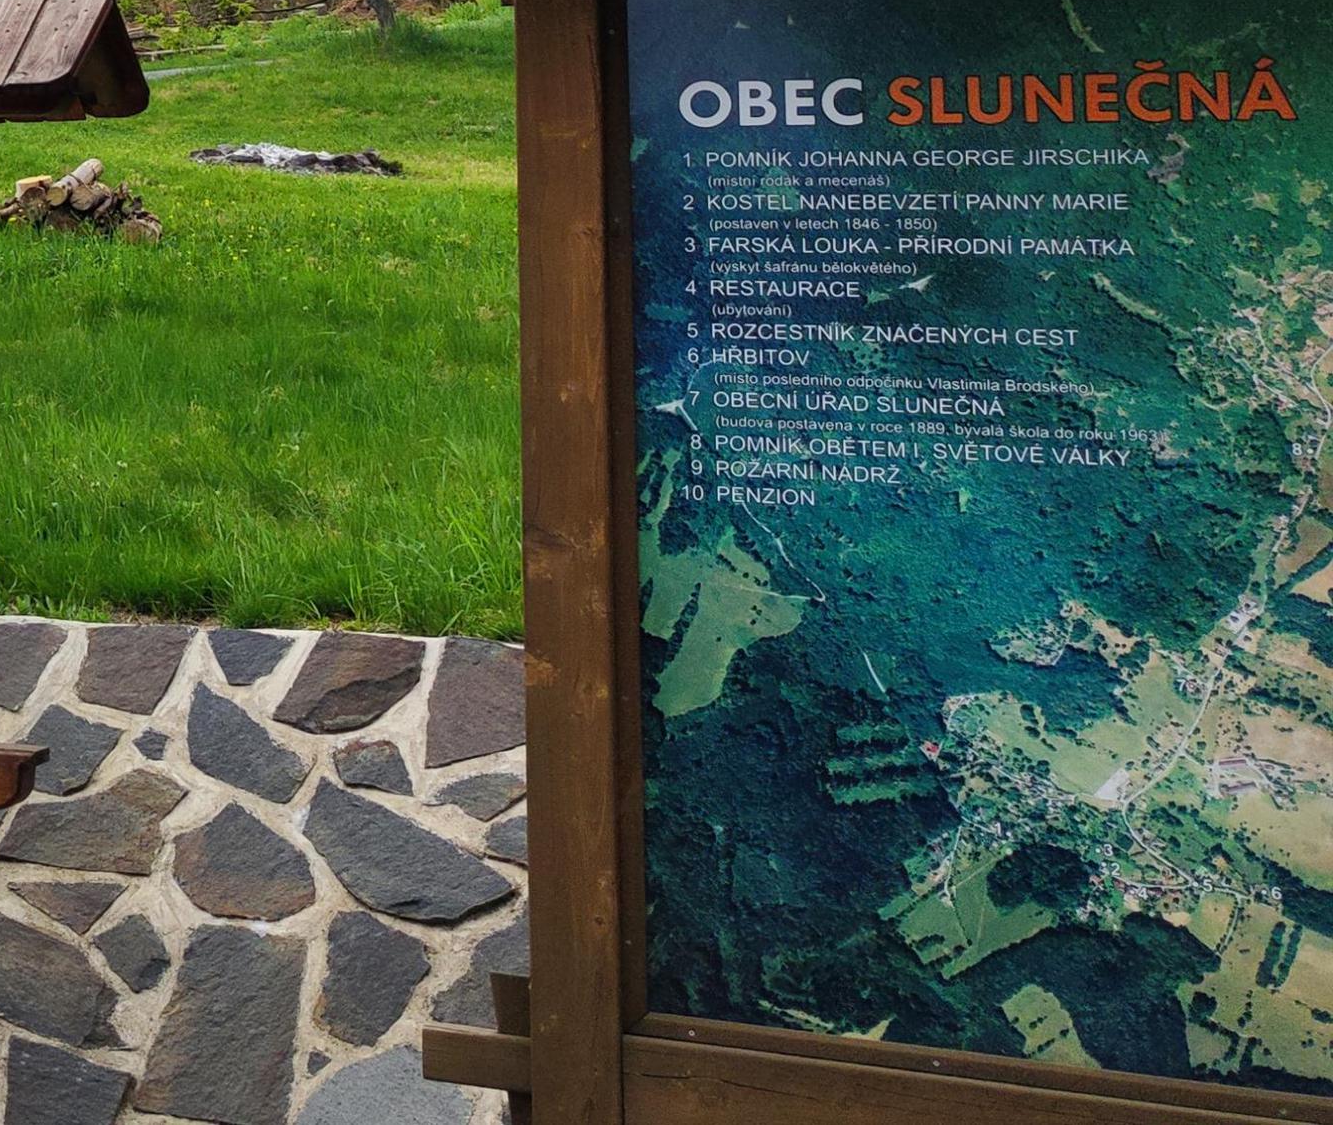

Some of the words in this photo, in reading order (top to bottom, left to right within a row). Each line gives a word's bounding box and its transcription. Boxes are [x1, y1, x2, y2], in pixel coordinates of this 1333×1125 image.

[678, 78, 864, 128] OBEC
[887, 56, 1298, 127] SLUNEČNÁ
[683, 153, 691, 168] 1
[706, 149, 792, 168] POMNÍK
[799, 150, 907, 167] JOHANNA
[913, 149, 1014, 167] GEORGE
[1023, 148, 1149, 166] JIRSCHIKA
[804, 177, 813, 187] a
[818, 173, 891, 187] mecenáš)
[683, 195, 694, 210] 2
[707, 194, 799, 210] KOSTEL
[800, 190, 958, 210] NANEBEVZETÍ
[966, 194, 1044, 210] PANNY
[1053, 193, 1129, 210] MARIE
[709, 218, 779, 232] (postaven
[783, 221, 791, 229] v
[795, 218, 839, 230] letech
[845, 219, 880, 230] 1846
[896, 218, 938, 232] 1850)
[684, 238, 696, 253] 3
[709, 235, 795, 254] FARSKÁ
[802, 238, 879, 254] LOUKA
[899, 235, 1013, 255] PŘÍRODNÍ
[1021, 236, 1135, 256] PAMÁTKA
[710, 262, 760, 275] (výskyt
[764, 262, 818, 274] šafránu
[823, 262, 918, 276] bělokvětého)
[685, 281, 696, 295] 4
[710, 280, 861, 297] RESTAURACE
[687, 324, 698, 338] 5
[712, 322, 854, 341] ROZCESTNÍK
[862, 324, 1007, 344] ZNAČENÝCH
[1015, 329, 1079, 346] CEST
[687, 349, 699, 363] 6
[713, 346, 810, 366] HŘBITOV
[847, 375, 922, 390] odpočinku
[927, 378, 1001, 391] Vlastimila
[1006, 380, 1094, 396] Brodského)
[689, 391, 701, 406] 7
[713, 390, 798, 409] OBECNÍ
[806, 390, 869, 412] ÚŘAD
[877, 395, 1006, 416] SLUNEČNÁ
[715, 416, 773, 430] (budova
[778, 417, 852, 433] postavena
[857, 423, 866, 431] v
[870, 424, 903, 433] roce
[955, 422, 1004, 439] bývalá
[1009, 425, 1050, 439] škola
[1057, 428, 1073, 440] do
[1079, 429, 1114, 441] roku
[690, 434, 702, 450] 8
[715, 433, 803, 452] POMNÍK
[809, 436, 906, 457] OBĚTEM
[933, 441, 1045, 463] SVĚTOVÉ
[1052, 446, 1131, 467] VÁLKY
[1292, 442, 1303, 456] 8
[691, 460, 703, 475] 9
[716, 458, 815, 480] POŽÁRNÍ
[823, 461, 901, 484] NÁDRŽ
[681, 485, 705, 501] 10
[717, 486, 816, 506] PENZION
[1103, 843, 1113, 857] 3
[1111, 862, 1121, 876] 2
[1138, 887, 1149, 900] 4
[1202, 879, 1213, 892] 5
[1271, 887, 1283, 900] 6
